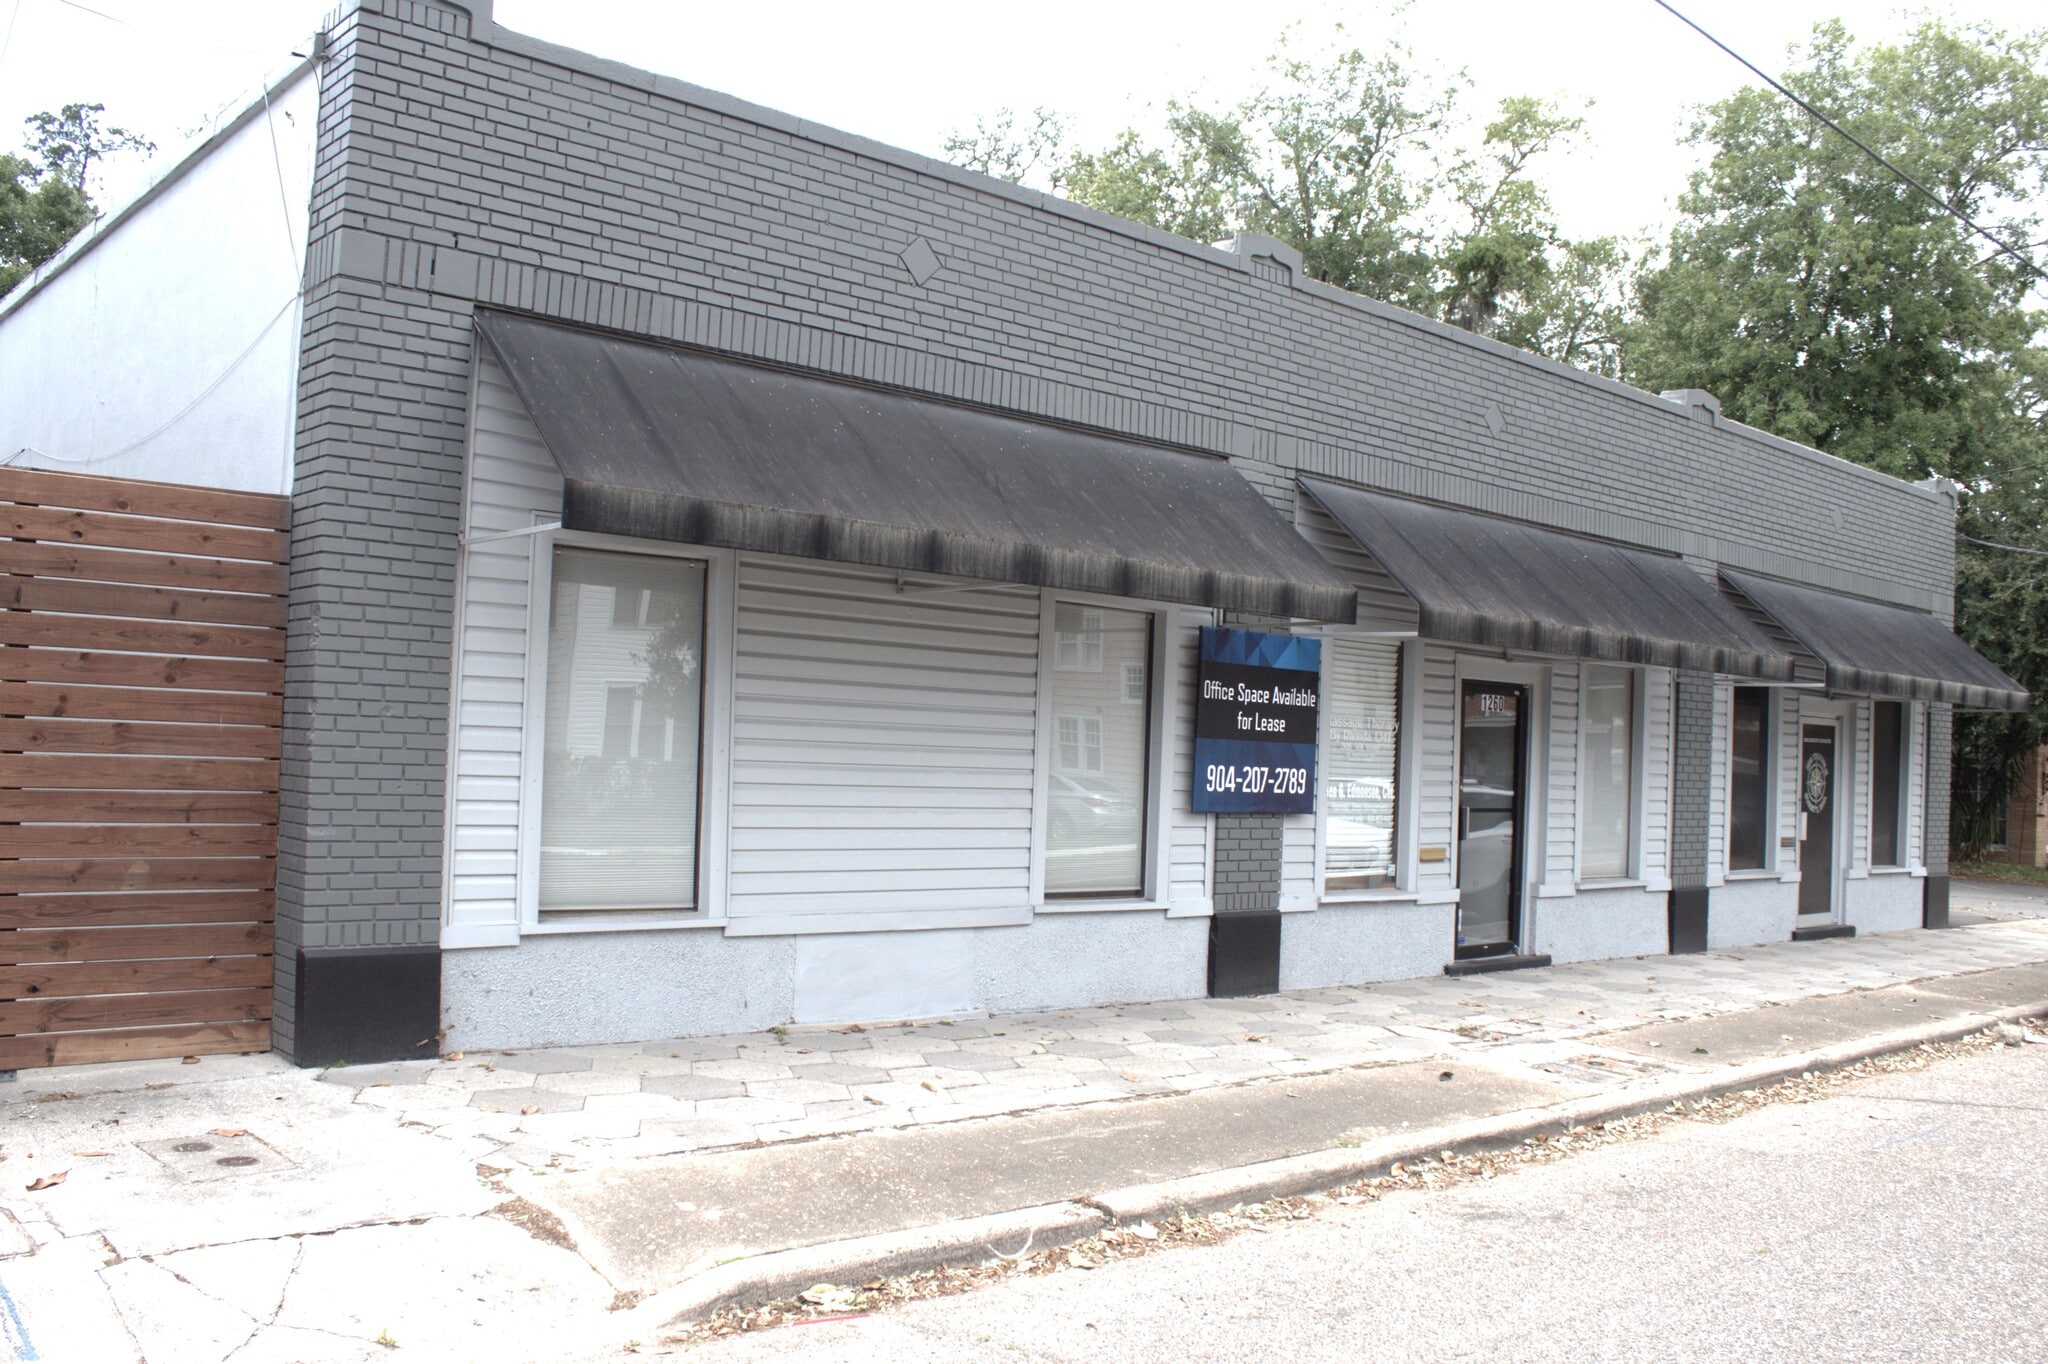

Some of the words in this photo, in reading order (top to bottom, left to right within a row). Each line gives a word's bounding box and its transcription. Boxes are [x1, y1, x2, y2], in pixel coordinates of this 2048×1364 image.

[1203, 679, 1235, 701] Office
[1237, 682, 1270, 705] Space
[1272, 686, 1317, 707] Available
[1482, 694, 1504, 712] 1260
[1237, 711, 1252, 730] for
[1254, 712, 1286, 732] Lease
[1364, 716, 1399, 733] Therapy
[1329, 728, 1340, 743] By
[1206, 764, 1307, 794] 904-207-2789
